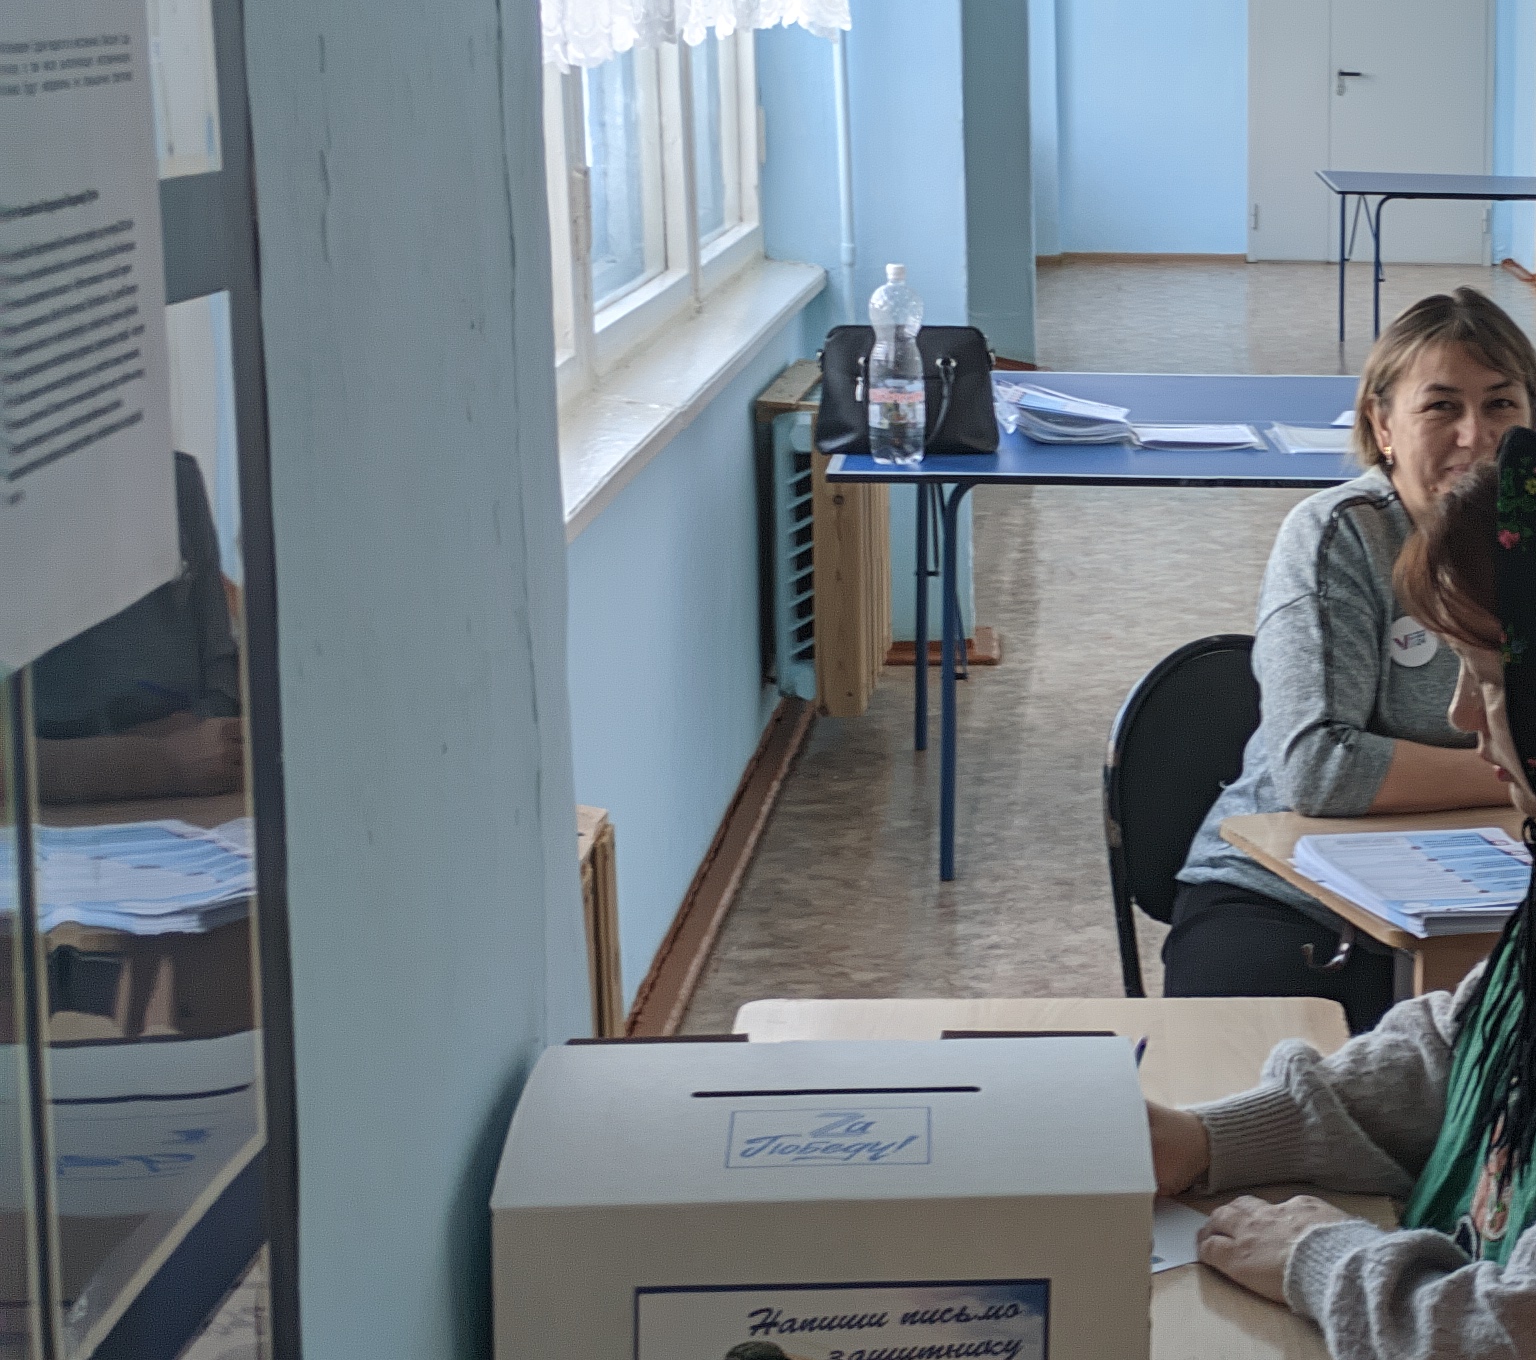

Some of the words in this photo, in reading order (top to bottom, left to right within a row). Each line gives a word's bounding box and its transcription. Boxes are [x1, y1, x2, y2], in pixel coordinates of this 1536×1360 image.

[740, 1134, 920, 1162] Победу!
[748, 1307, 890, 1336] Напиши
[900, 1302, 1023, 1327] письмо
